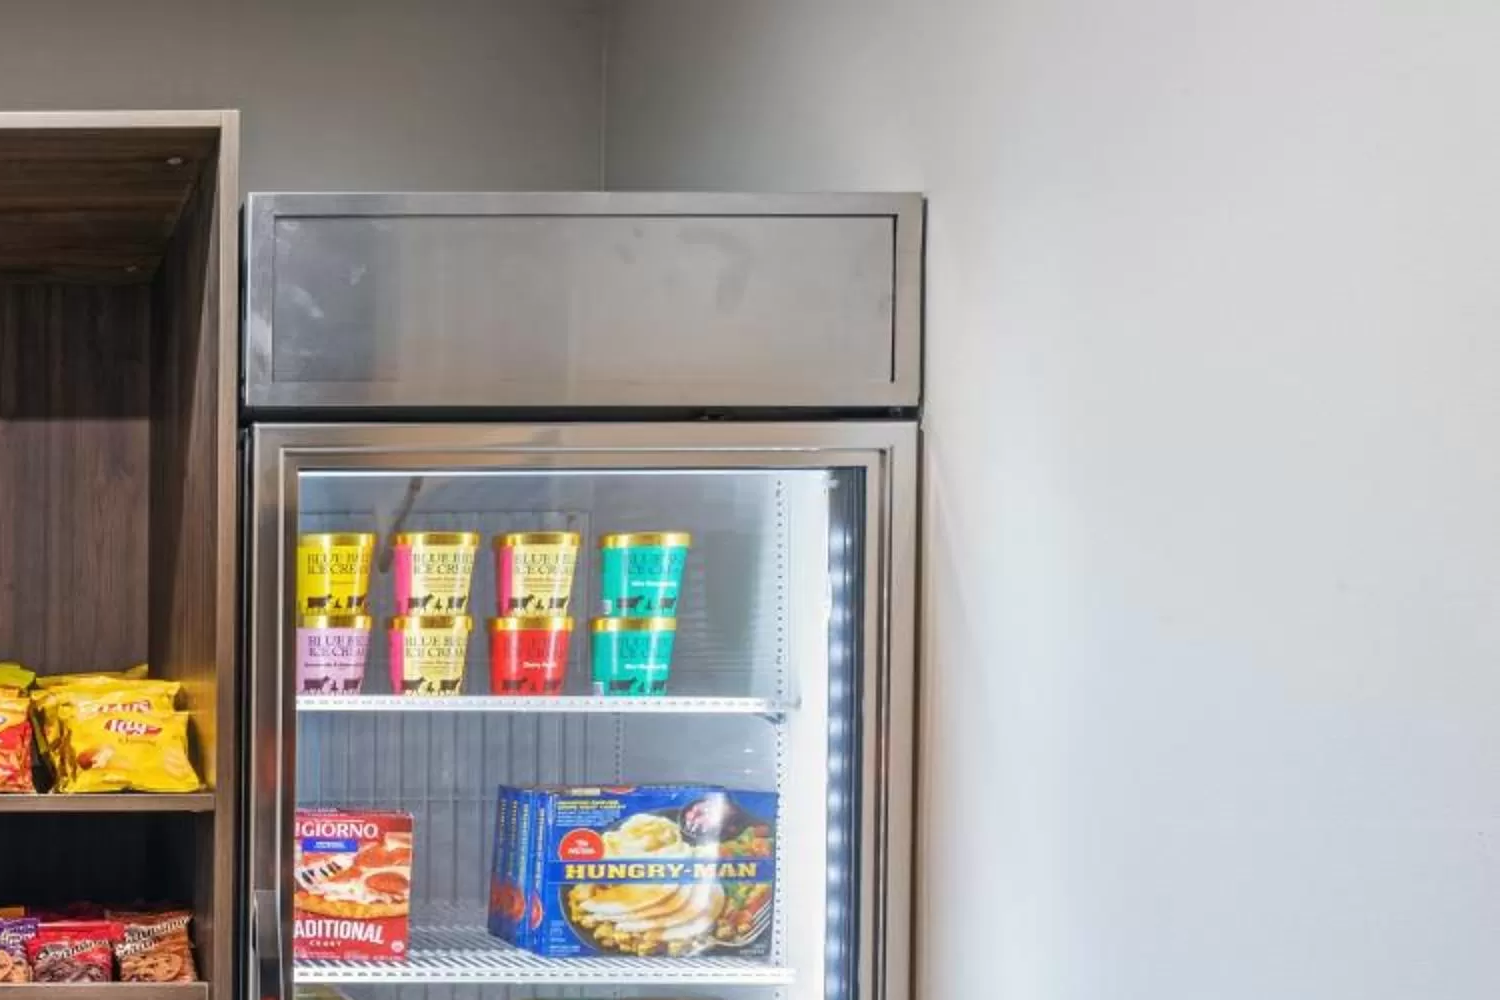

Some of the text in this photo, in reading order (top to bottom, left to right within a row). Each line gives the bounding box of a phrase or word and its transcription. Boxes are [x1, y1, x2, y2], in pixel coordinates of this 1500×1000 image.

[295, 822, 379, 838] IGIORNO
[565, 863, 758, 879] HUNGRY-MAN
[294, 919, 385, 945] ADITIONAL
